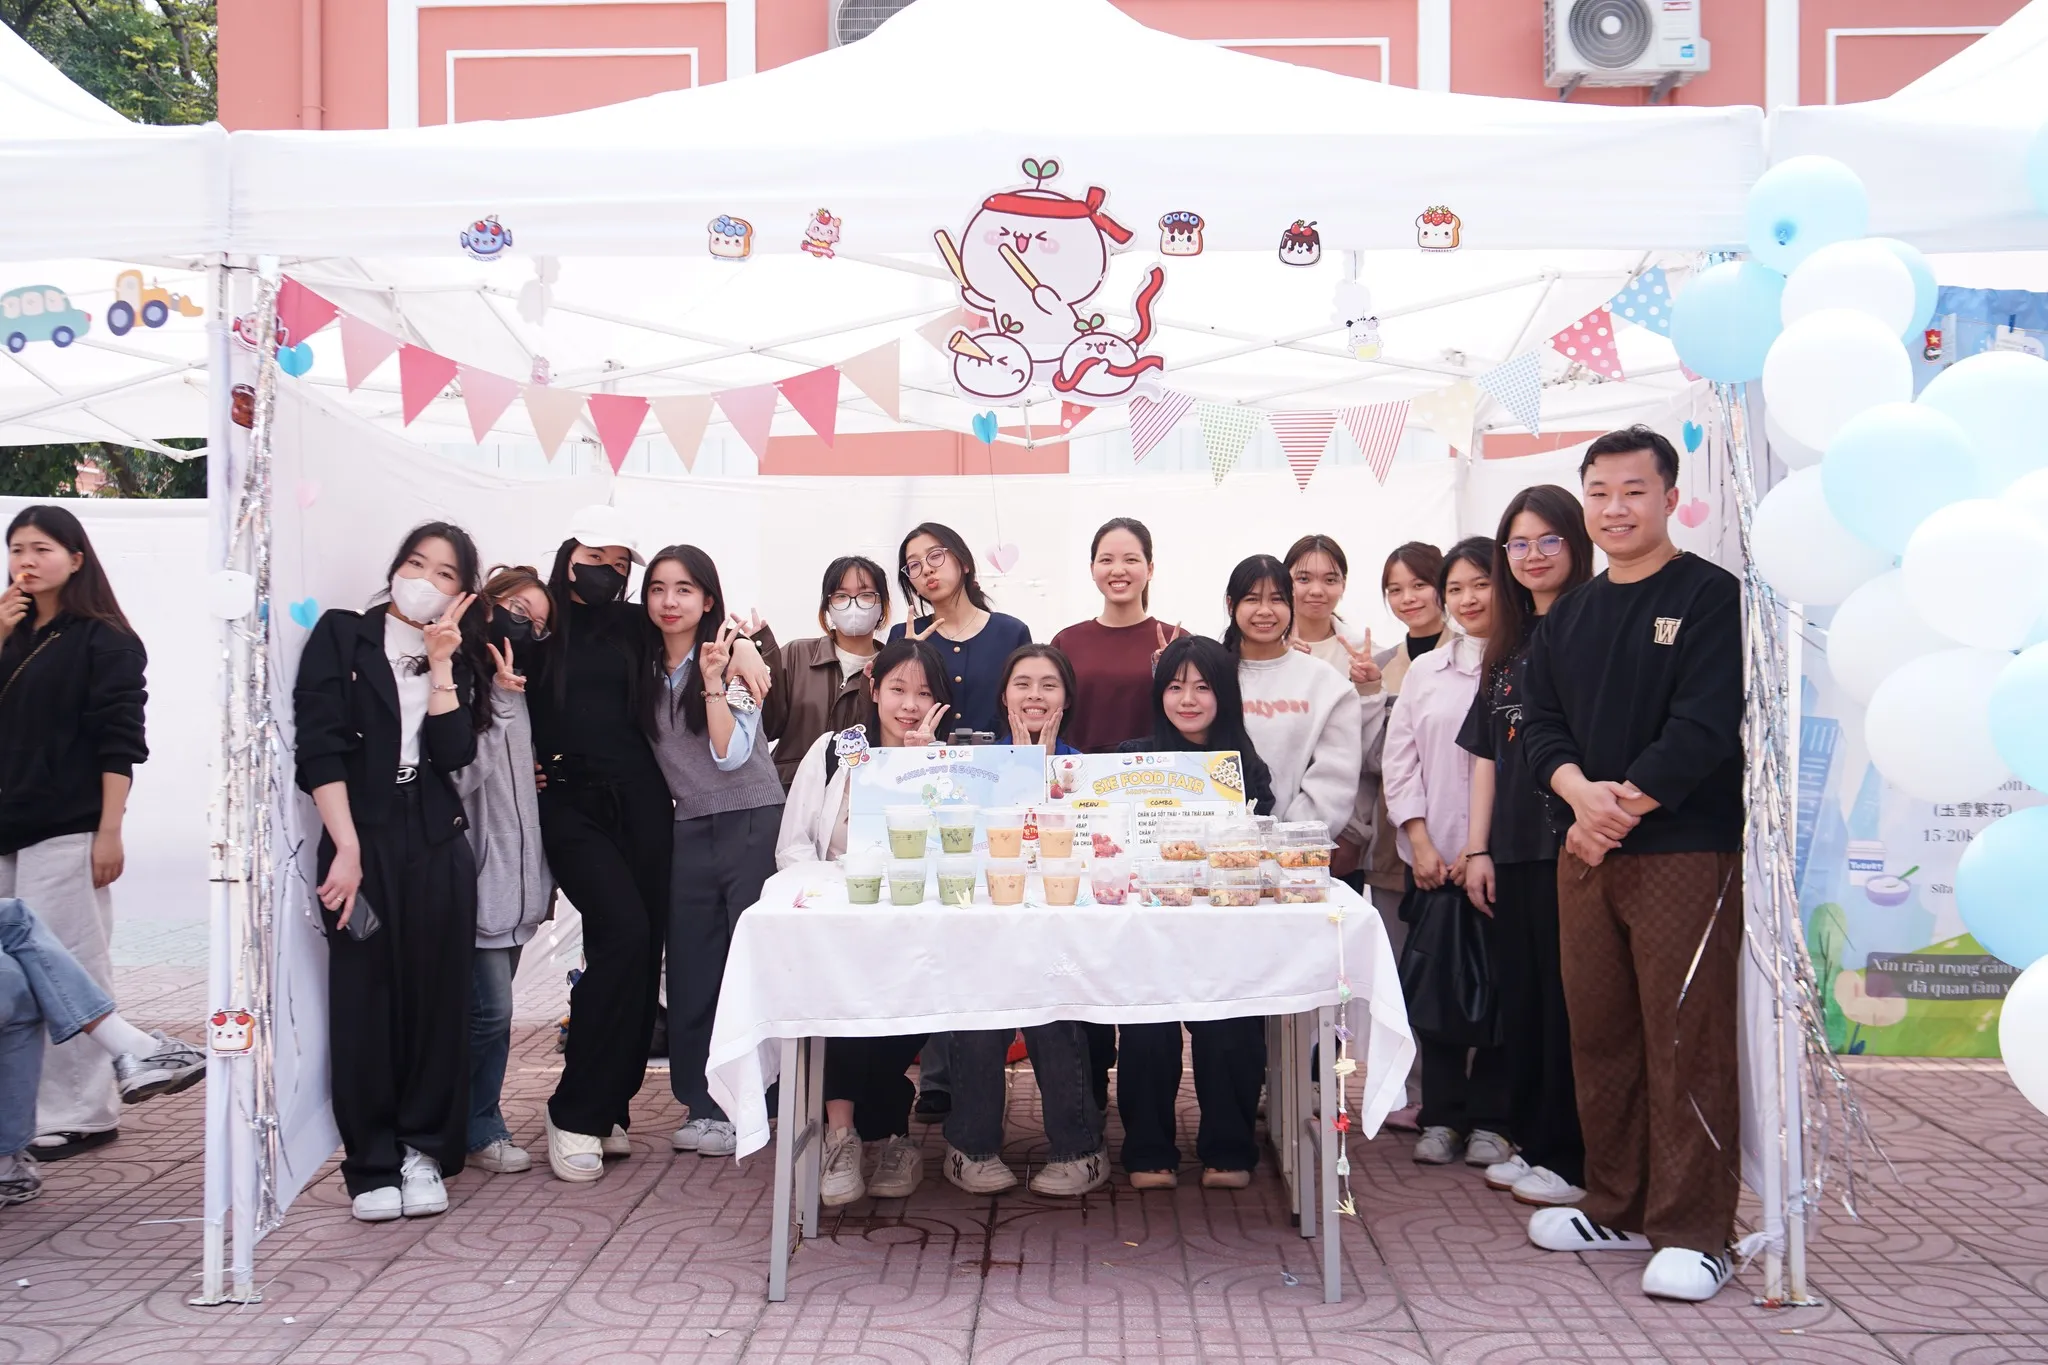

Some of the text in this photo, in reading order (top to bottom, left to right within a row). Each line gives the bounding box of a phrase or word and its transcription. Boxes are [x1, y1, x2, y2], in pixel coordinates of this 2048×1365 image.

[1654, 617, 1683, 645] W
[1092, 771, 1205, 795] SIE FOOD FAIR
[1930, 983, 1970, 997] quan
